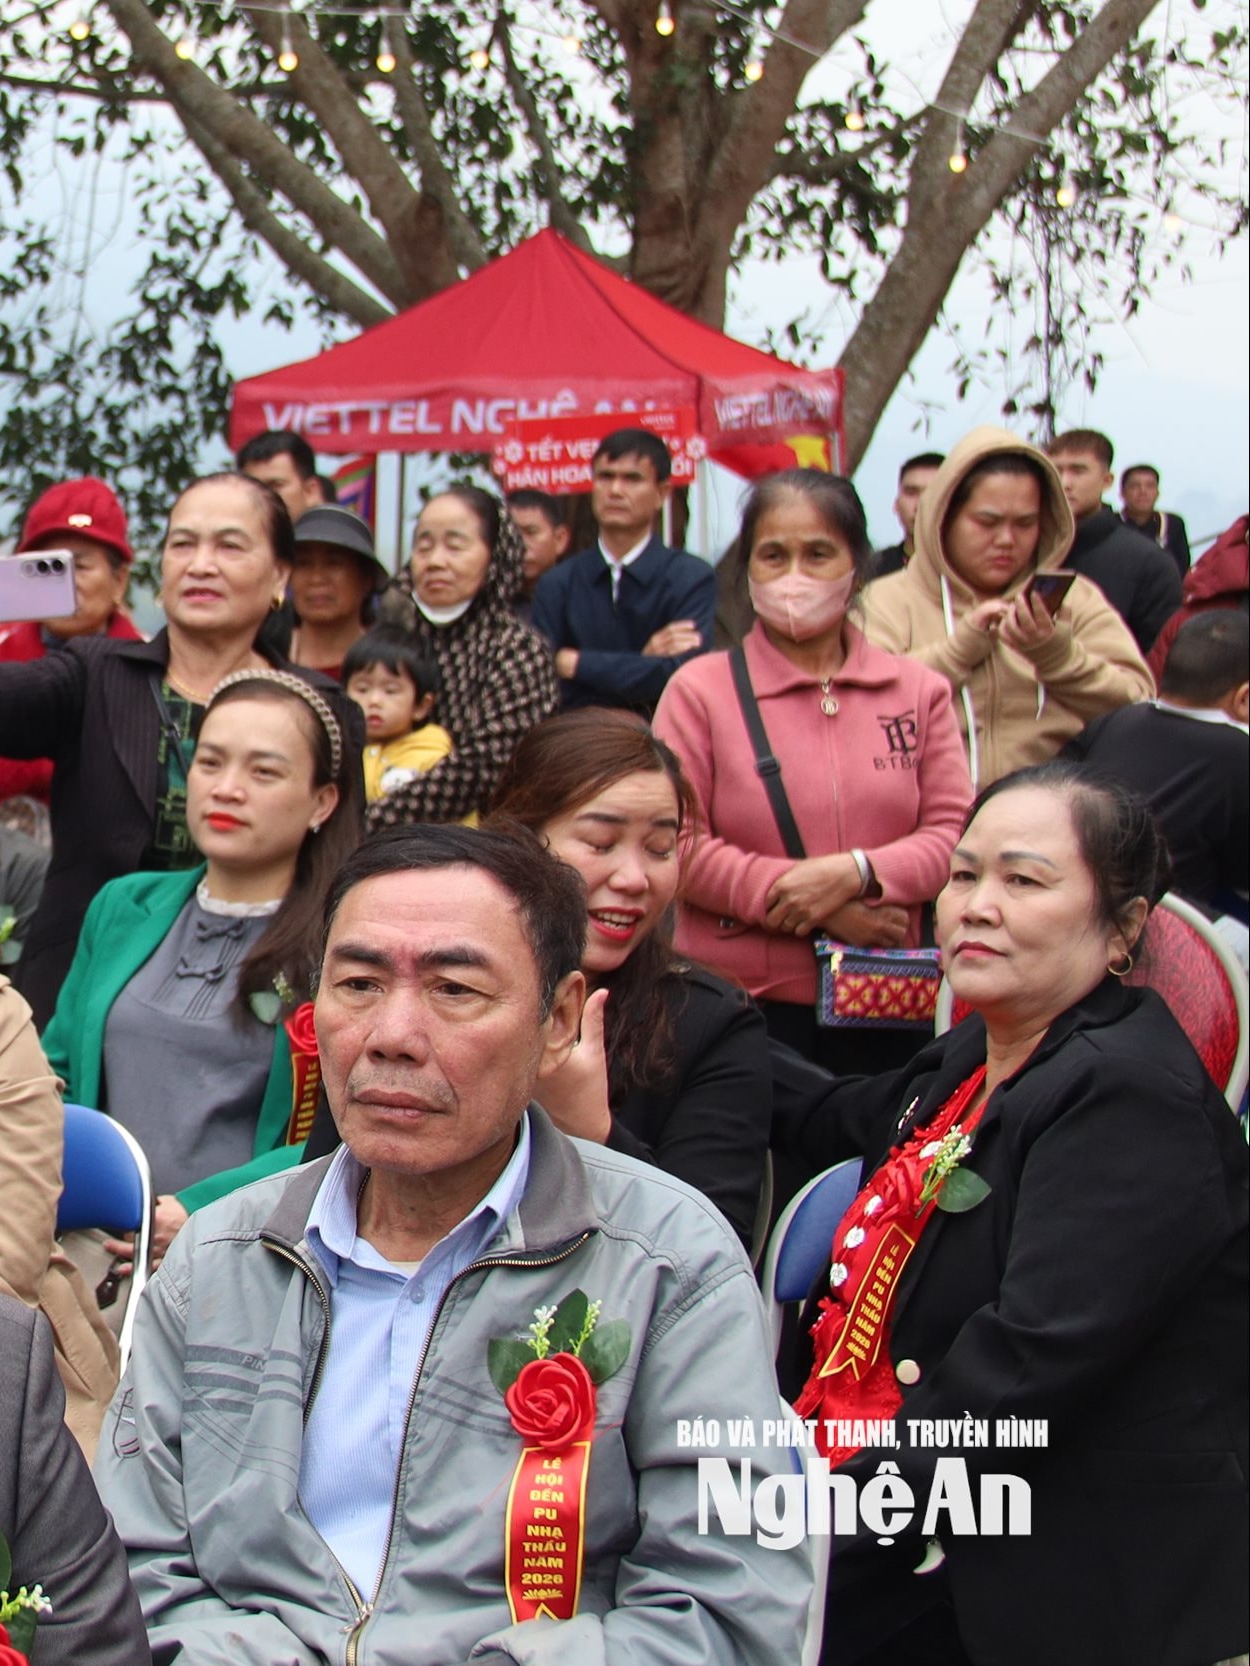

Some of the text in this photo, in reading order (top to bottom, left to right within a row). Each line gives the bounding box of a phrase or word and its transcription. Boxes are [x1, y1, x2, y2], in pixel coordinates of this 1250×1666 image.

[262, 401, 442, 434] VIETTEL
[526, 435, 562, 461] TẾT
[533, 1507, 558, 1520] PU
[527, 1524, 564, 1540] NHẠ
[521, 1573, 564, 1585] 2026
